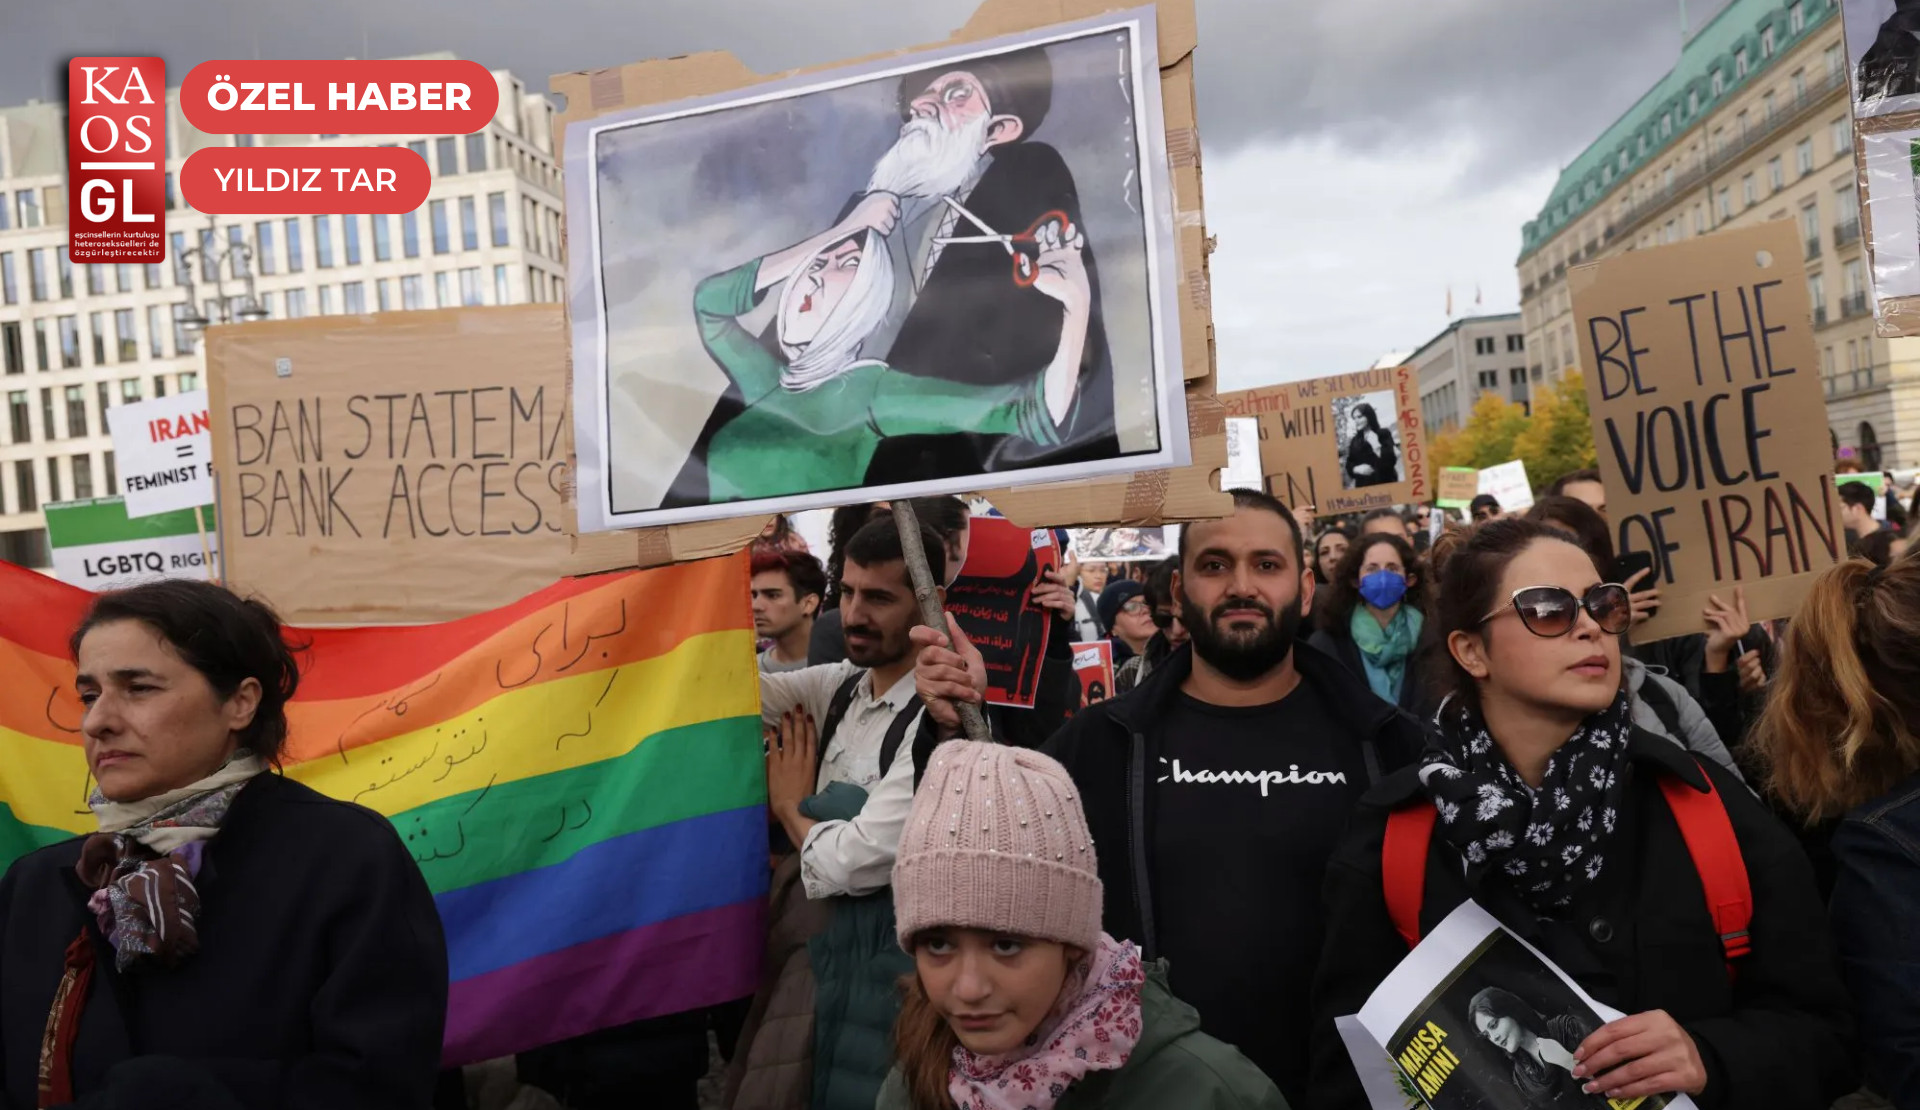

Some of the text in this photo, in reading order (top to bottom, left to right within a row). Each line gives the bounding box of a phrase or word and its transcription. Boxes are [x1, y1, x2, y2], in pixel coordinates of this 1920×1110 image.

[1588, 279, 1796, 401] BE THE
[1297, 379, 1319, 398] WE
[148, 409, 210, 443] IRAN
[232, 397, 323, 465] BAN
[1280, 405, 1325, 440] WITH
[1605, 383, 1780, 495] VOICE
[126, 464, 197, 493] FEMINIST
[239, 467, 361, 538] BANK
[1264, 466, 1318, 514] EN
[1702, 474, 1838, 581] IRAN
[84, 551, 165, 578] LGBTQ
[497, 598, 626, 688] برای
[1398, 1020, 1448, 1078] MAHSA
[1416, 1045, 1460, 1100] AMINI
